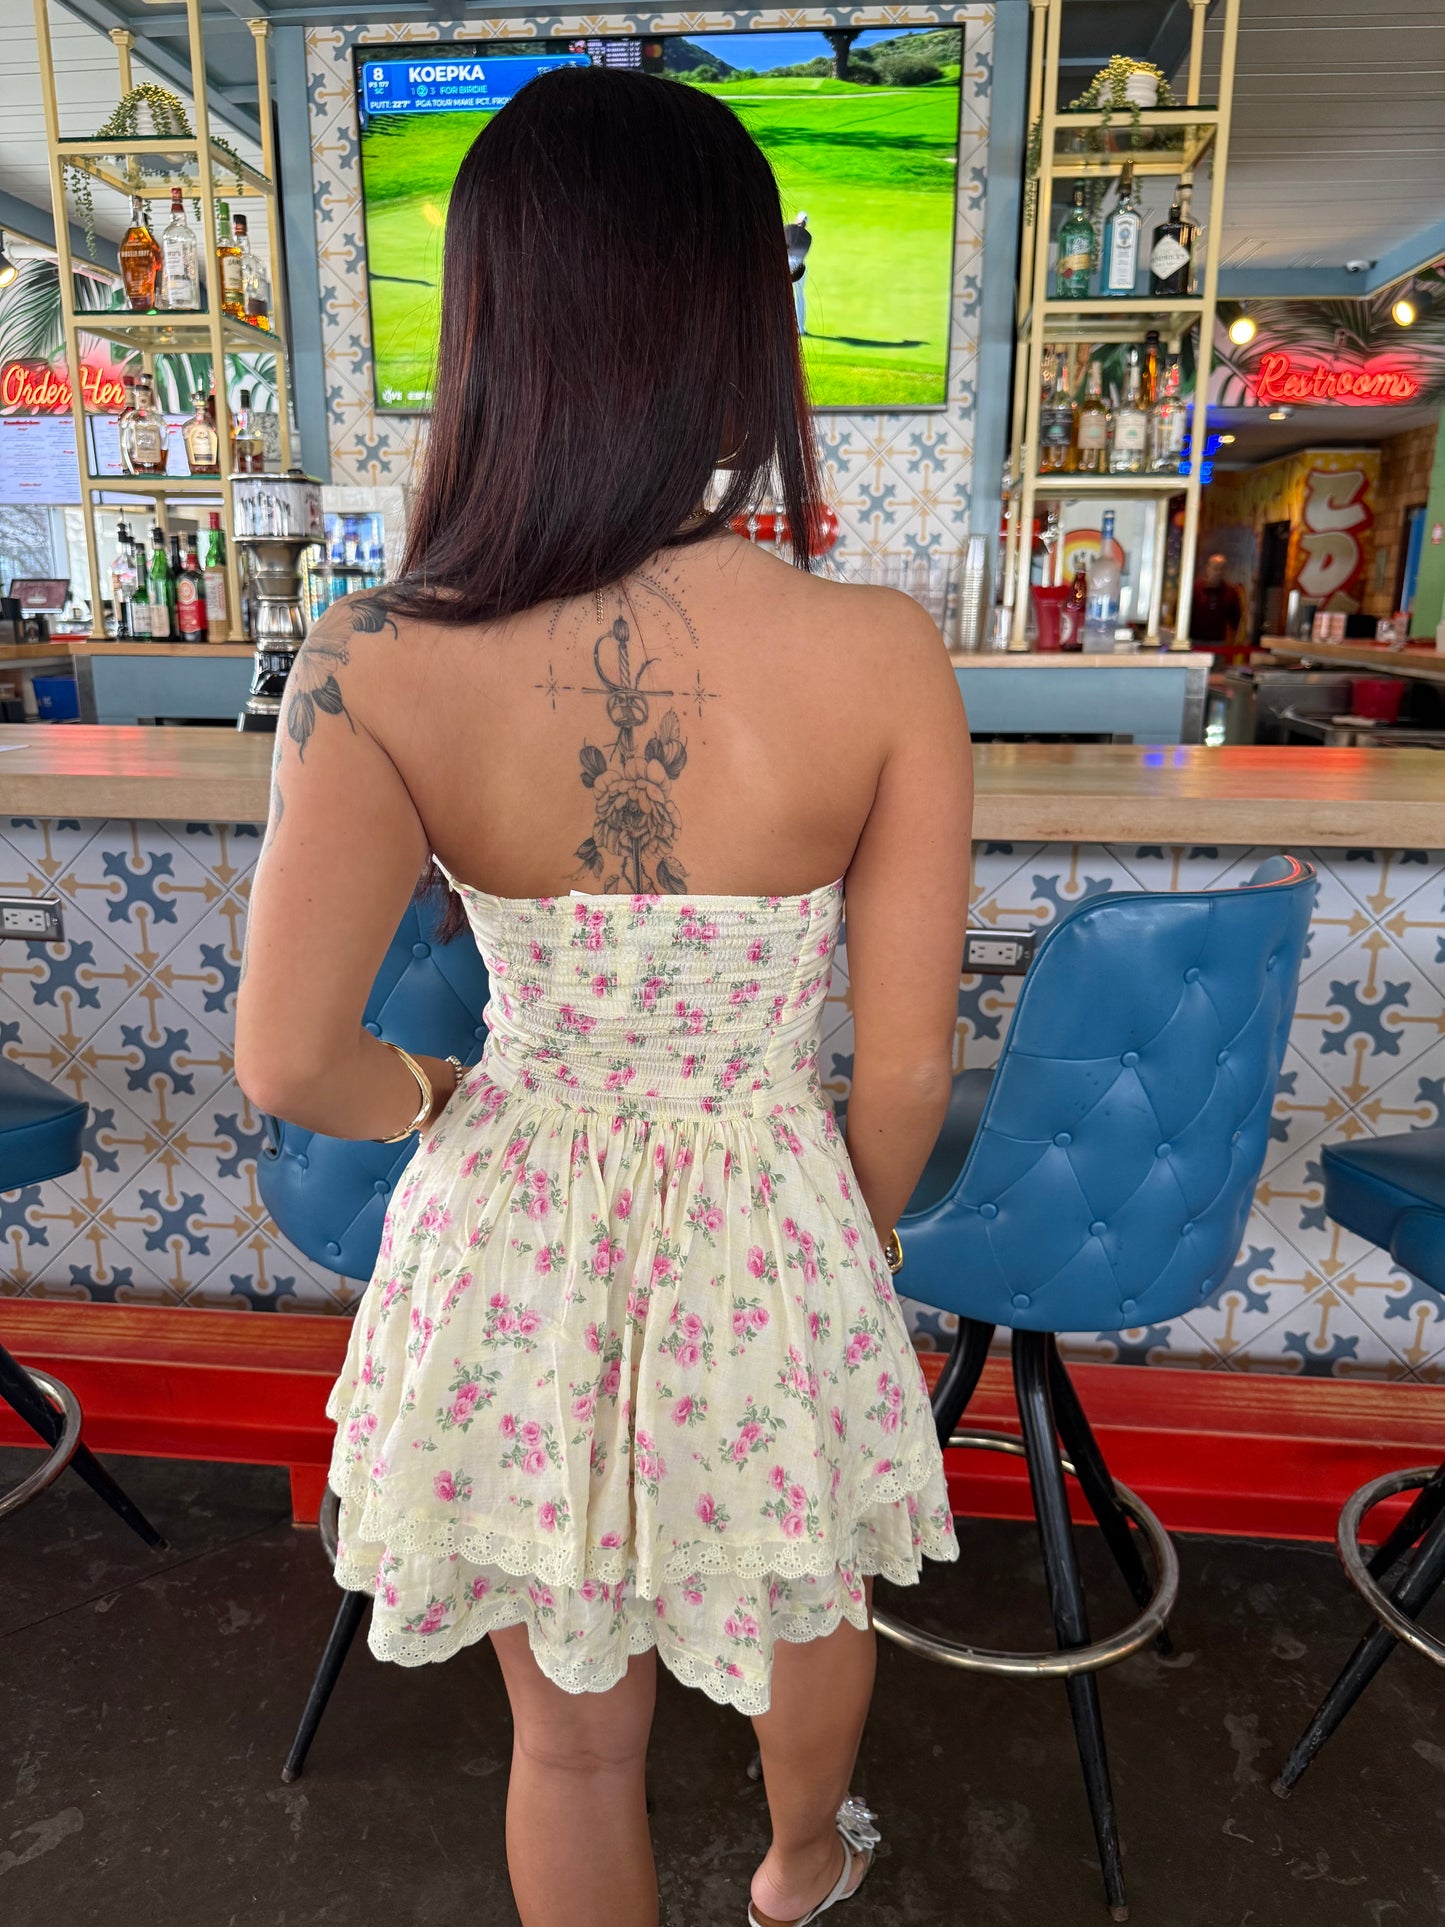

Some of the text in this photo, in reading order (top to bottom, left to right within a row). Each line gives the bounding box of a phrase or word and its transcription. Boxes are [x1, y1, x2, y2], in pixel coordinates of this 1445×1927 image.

[372, 67, 384, 81] 8
[408, 64, 485, 83] KOEPKA
[440, 86, 458, 95] FOR
[459, 85, 488, 94] BIRDIE
[415, 99, 431, 108] PGA
[432, 99, 453, 107] TOUR
[453, 98, 475, 106] MAKE
[1257, 353, 1417, 398] Restrooms
[3, 364, 126, 406] Order Her
